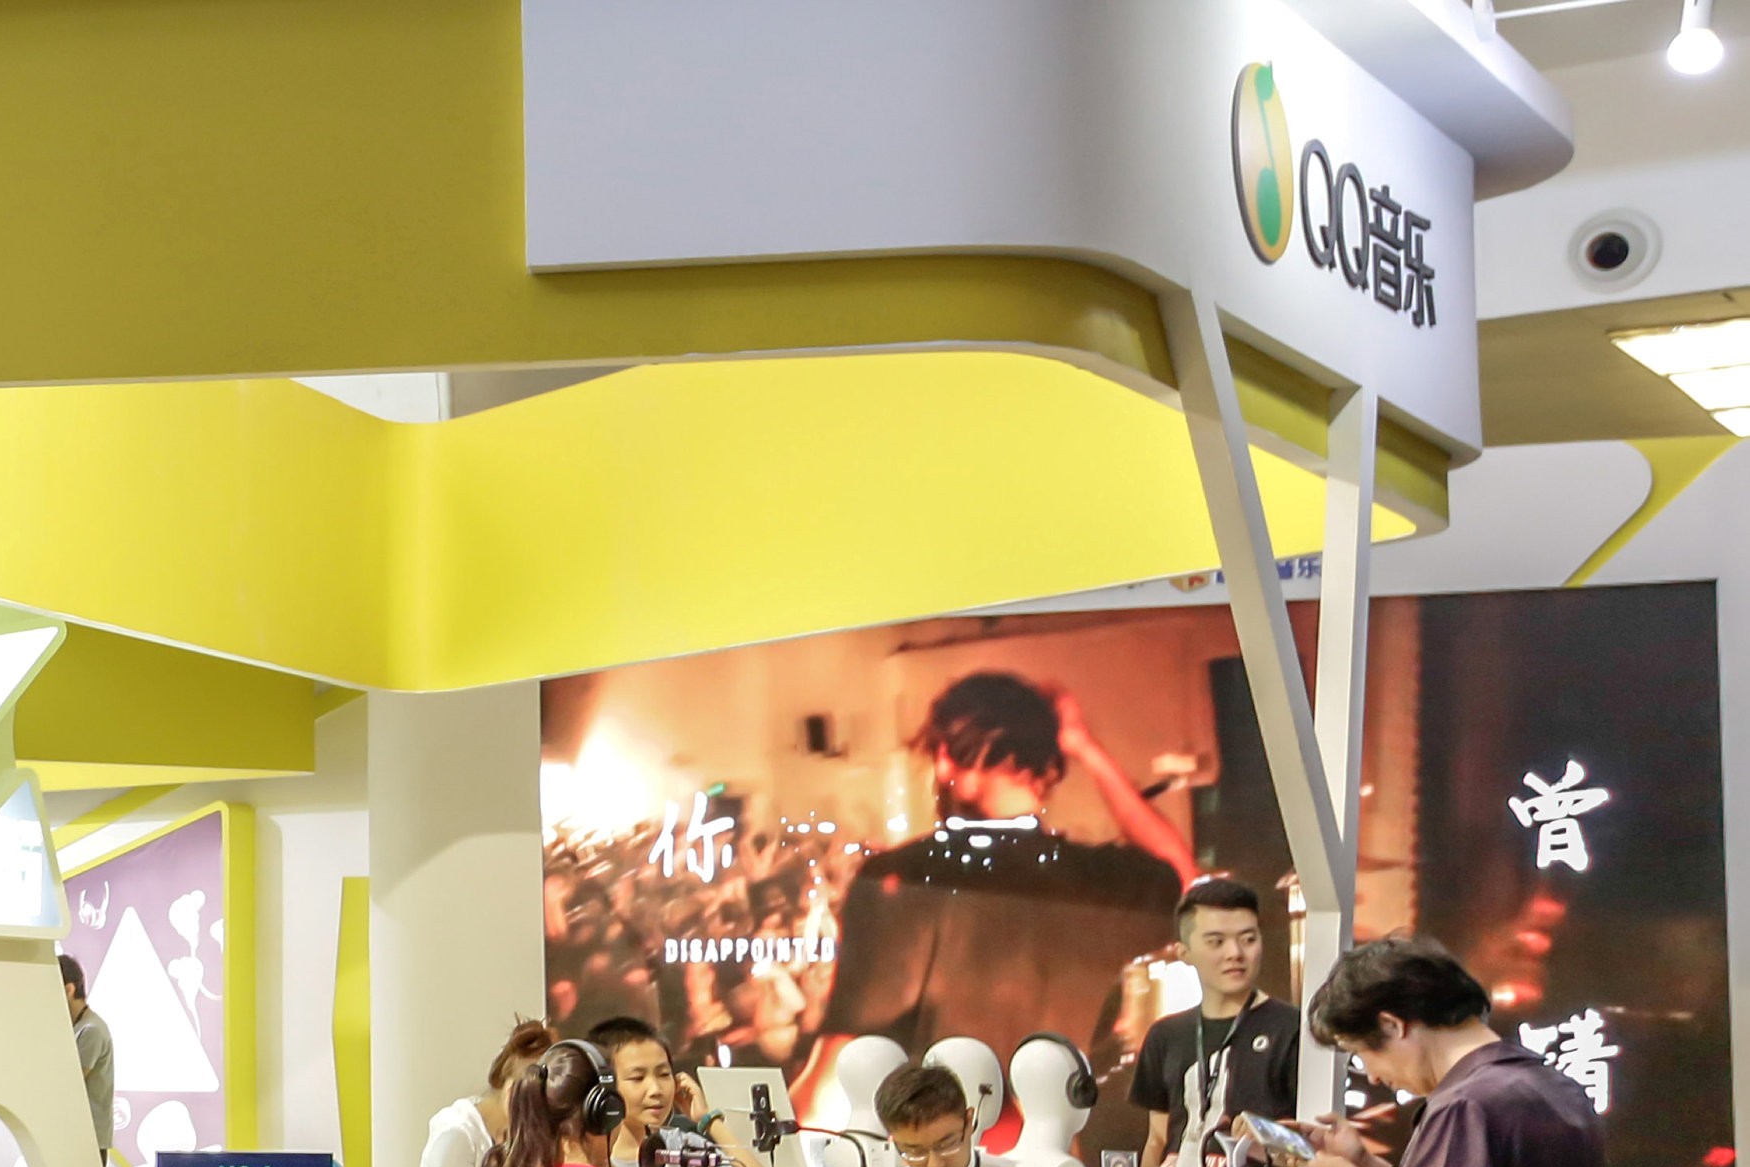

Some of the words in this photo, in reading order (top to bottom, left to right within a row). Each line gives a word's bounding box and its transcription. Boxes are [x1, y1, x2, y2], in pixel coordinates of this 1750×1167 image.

[1300, 138, 1437, 329] QQ音乐
[648, 790, 735, 884] 你
[1508, 759, 1610, 872] 曾
[665, 937, 836, 963] DISAPPOINTED
